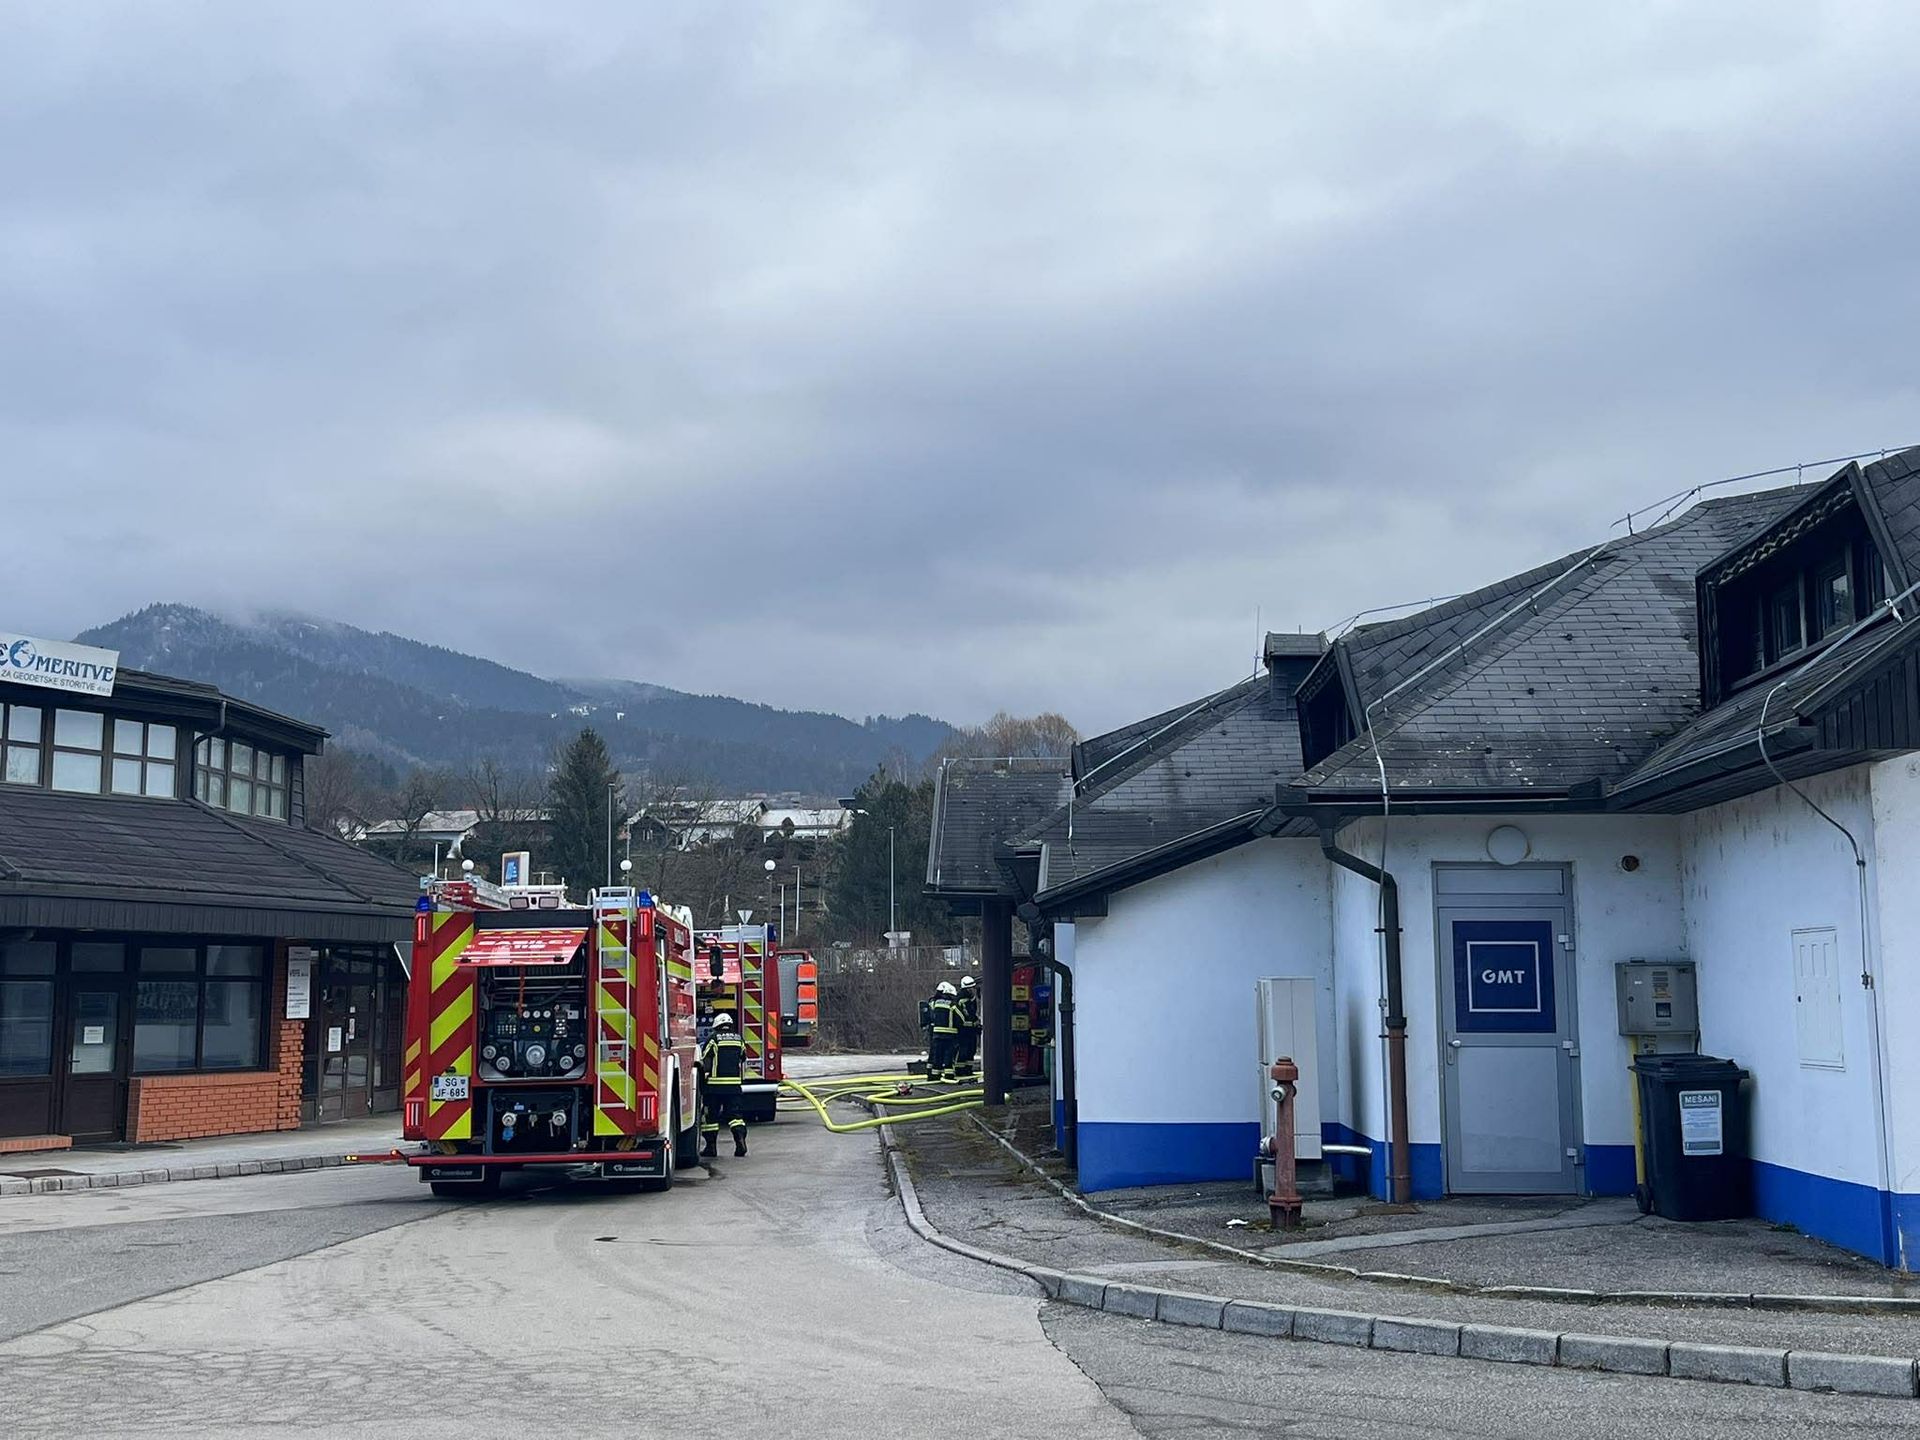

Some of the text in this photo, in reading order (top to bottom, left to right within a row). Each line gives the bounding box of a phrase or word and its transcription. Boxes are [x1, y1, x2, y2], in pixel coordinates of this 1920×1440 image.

[1, 669, 11, 678] ZA
[13, 671, 57, 686] GEODETSKE
[59, 678, 96, 691] STORITVE
[1482, 969, 1525, 984] GMT
[445, 1077, 457, 1087] SG
